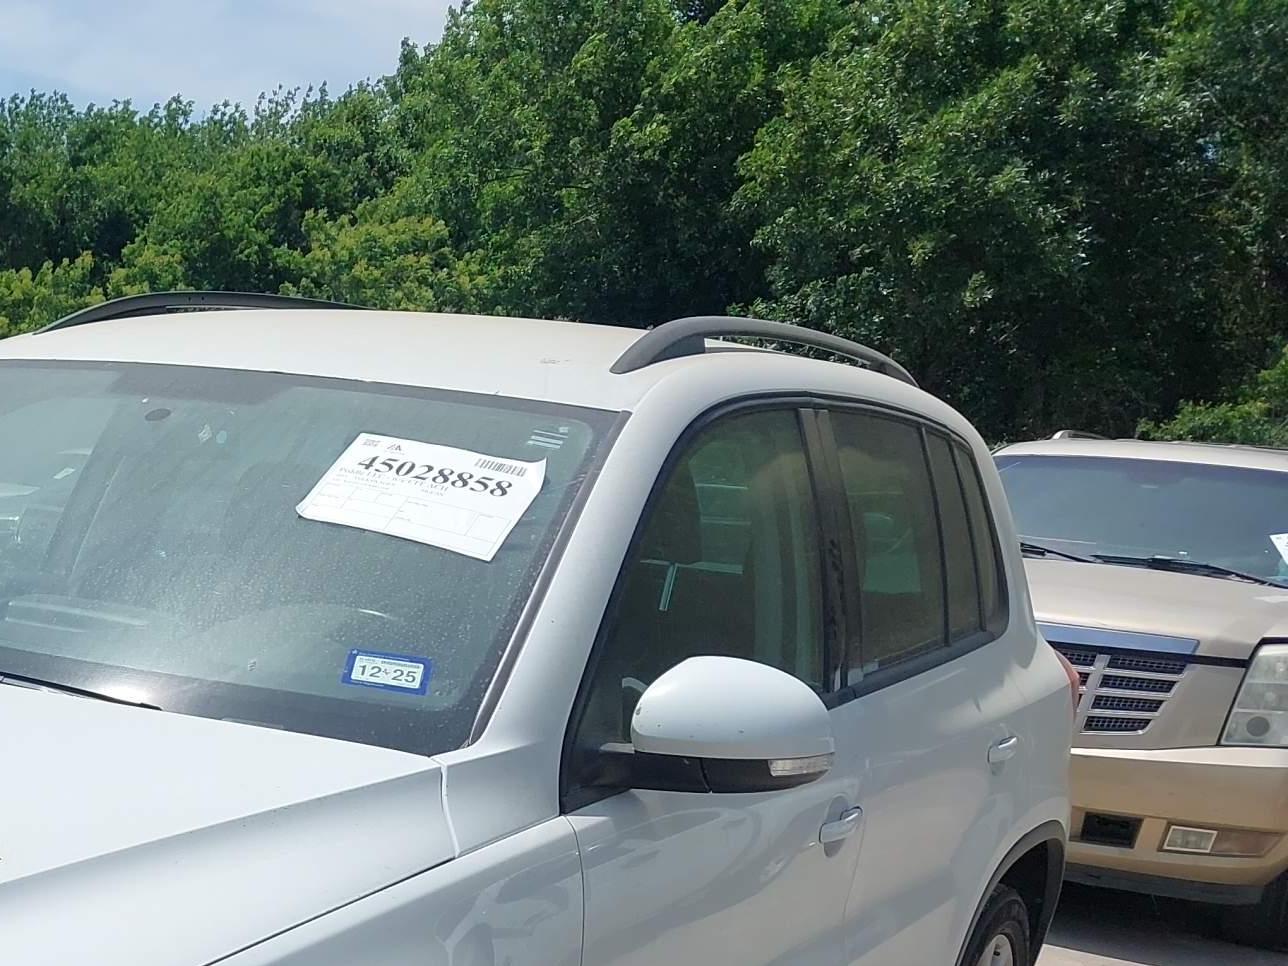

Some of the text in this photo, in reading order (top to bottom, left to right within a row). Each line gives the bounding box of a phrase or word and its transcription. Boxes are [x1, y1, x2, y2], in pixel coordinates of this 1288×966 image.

[357, 455, 513, 497] 45028858
[359, 664, 382, 678] 12
[391, 668, 417, 683] 25
